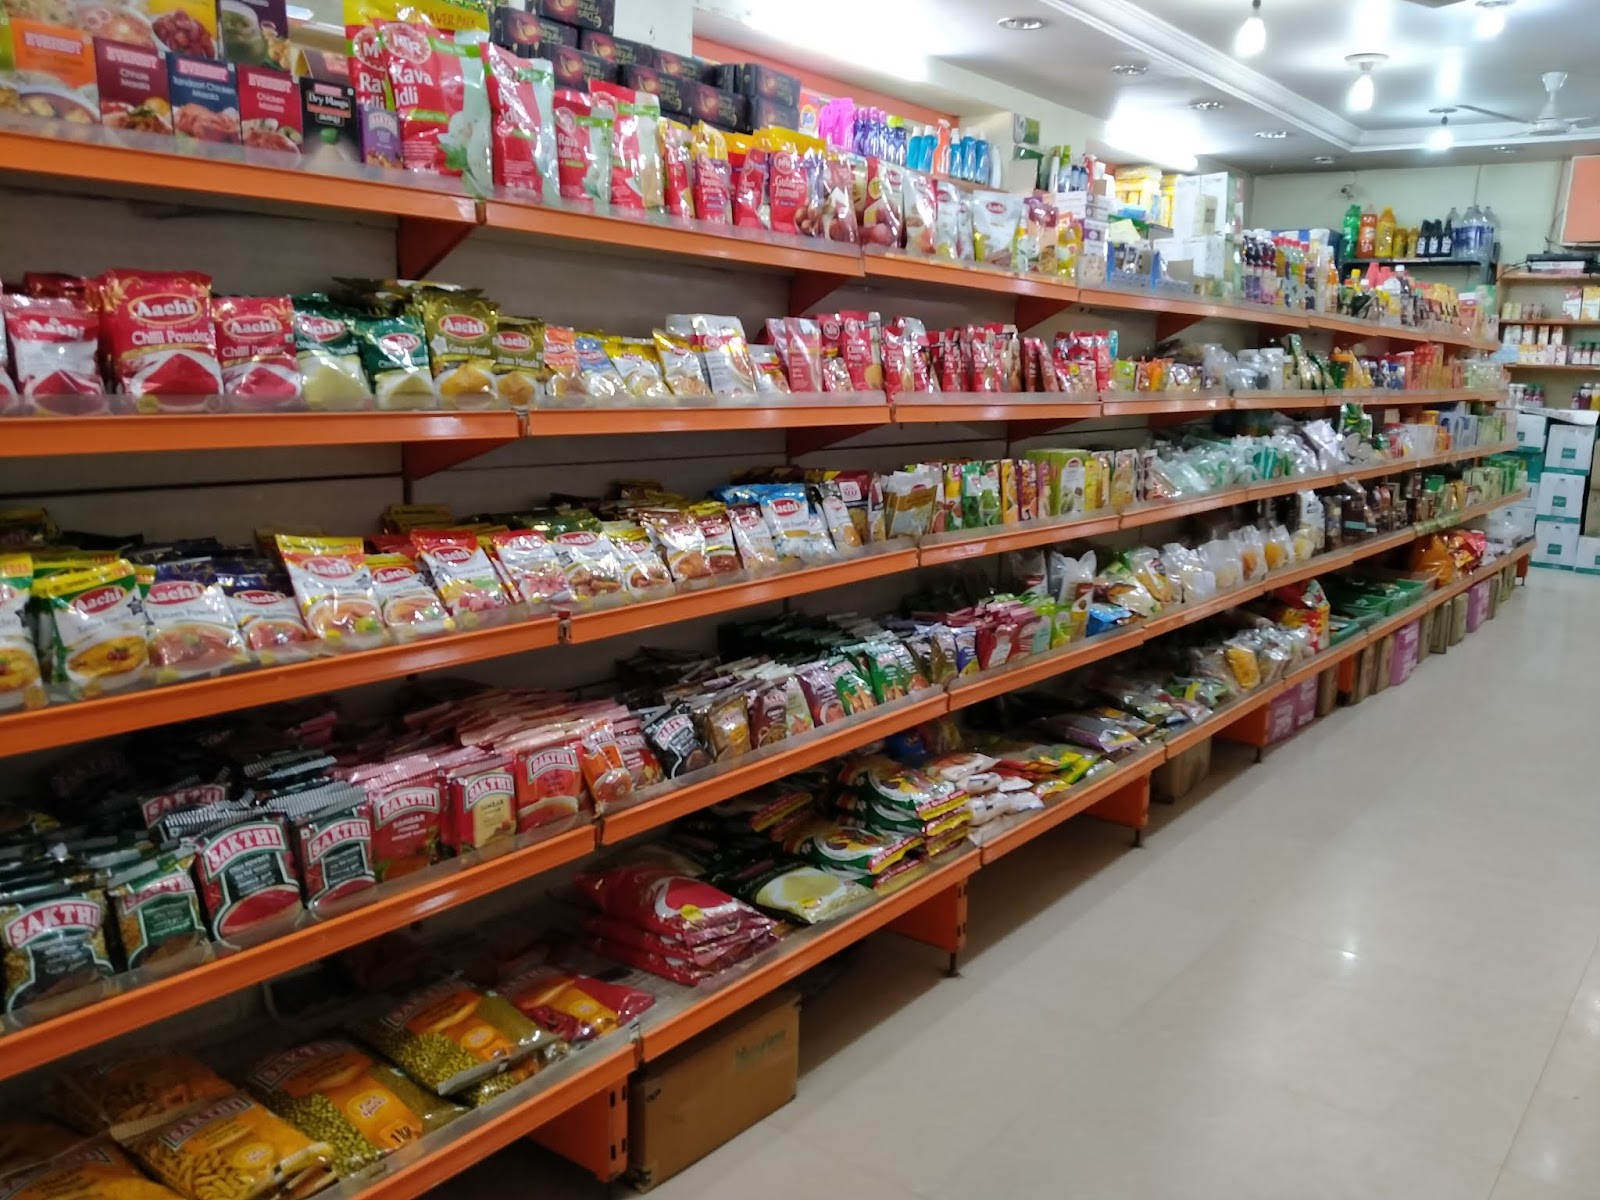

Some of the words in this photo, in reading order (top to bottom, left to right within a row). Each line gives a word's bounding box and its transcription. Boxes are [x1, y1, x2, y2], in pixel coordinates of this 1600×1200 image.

[390, 64, 434, 87] Rava
[394, 86, 419, 108] Idli
[136, 297, 197, 317] Aachi
[229, 320, 276, 334] Aachi
[443, 318, 487, 334] Aachi
[131, 330, 165, 346] Chilli
[497, 334, 530, 349] Aachi
[433, 547, 471, 564] Aachi
[305, 560, 353, 579] Aachi
[375, 567, 415, 584] Aachi
[73, 587, 124, 613] Aachi
[150, 582, 201, 603] Aachi
[531, 752, 575, 775] SAKTHI
[467, 776, 514, 803] SAKTHI
[380, 790, 436, 818] SAKTHI
[207, 825, 280, 870] SAKTHI
[311, 820, 370, 859] SAKTHI
[10, 902, 99, 947] SAKTHI
